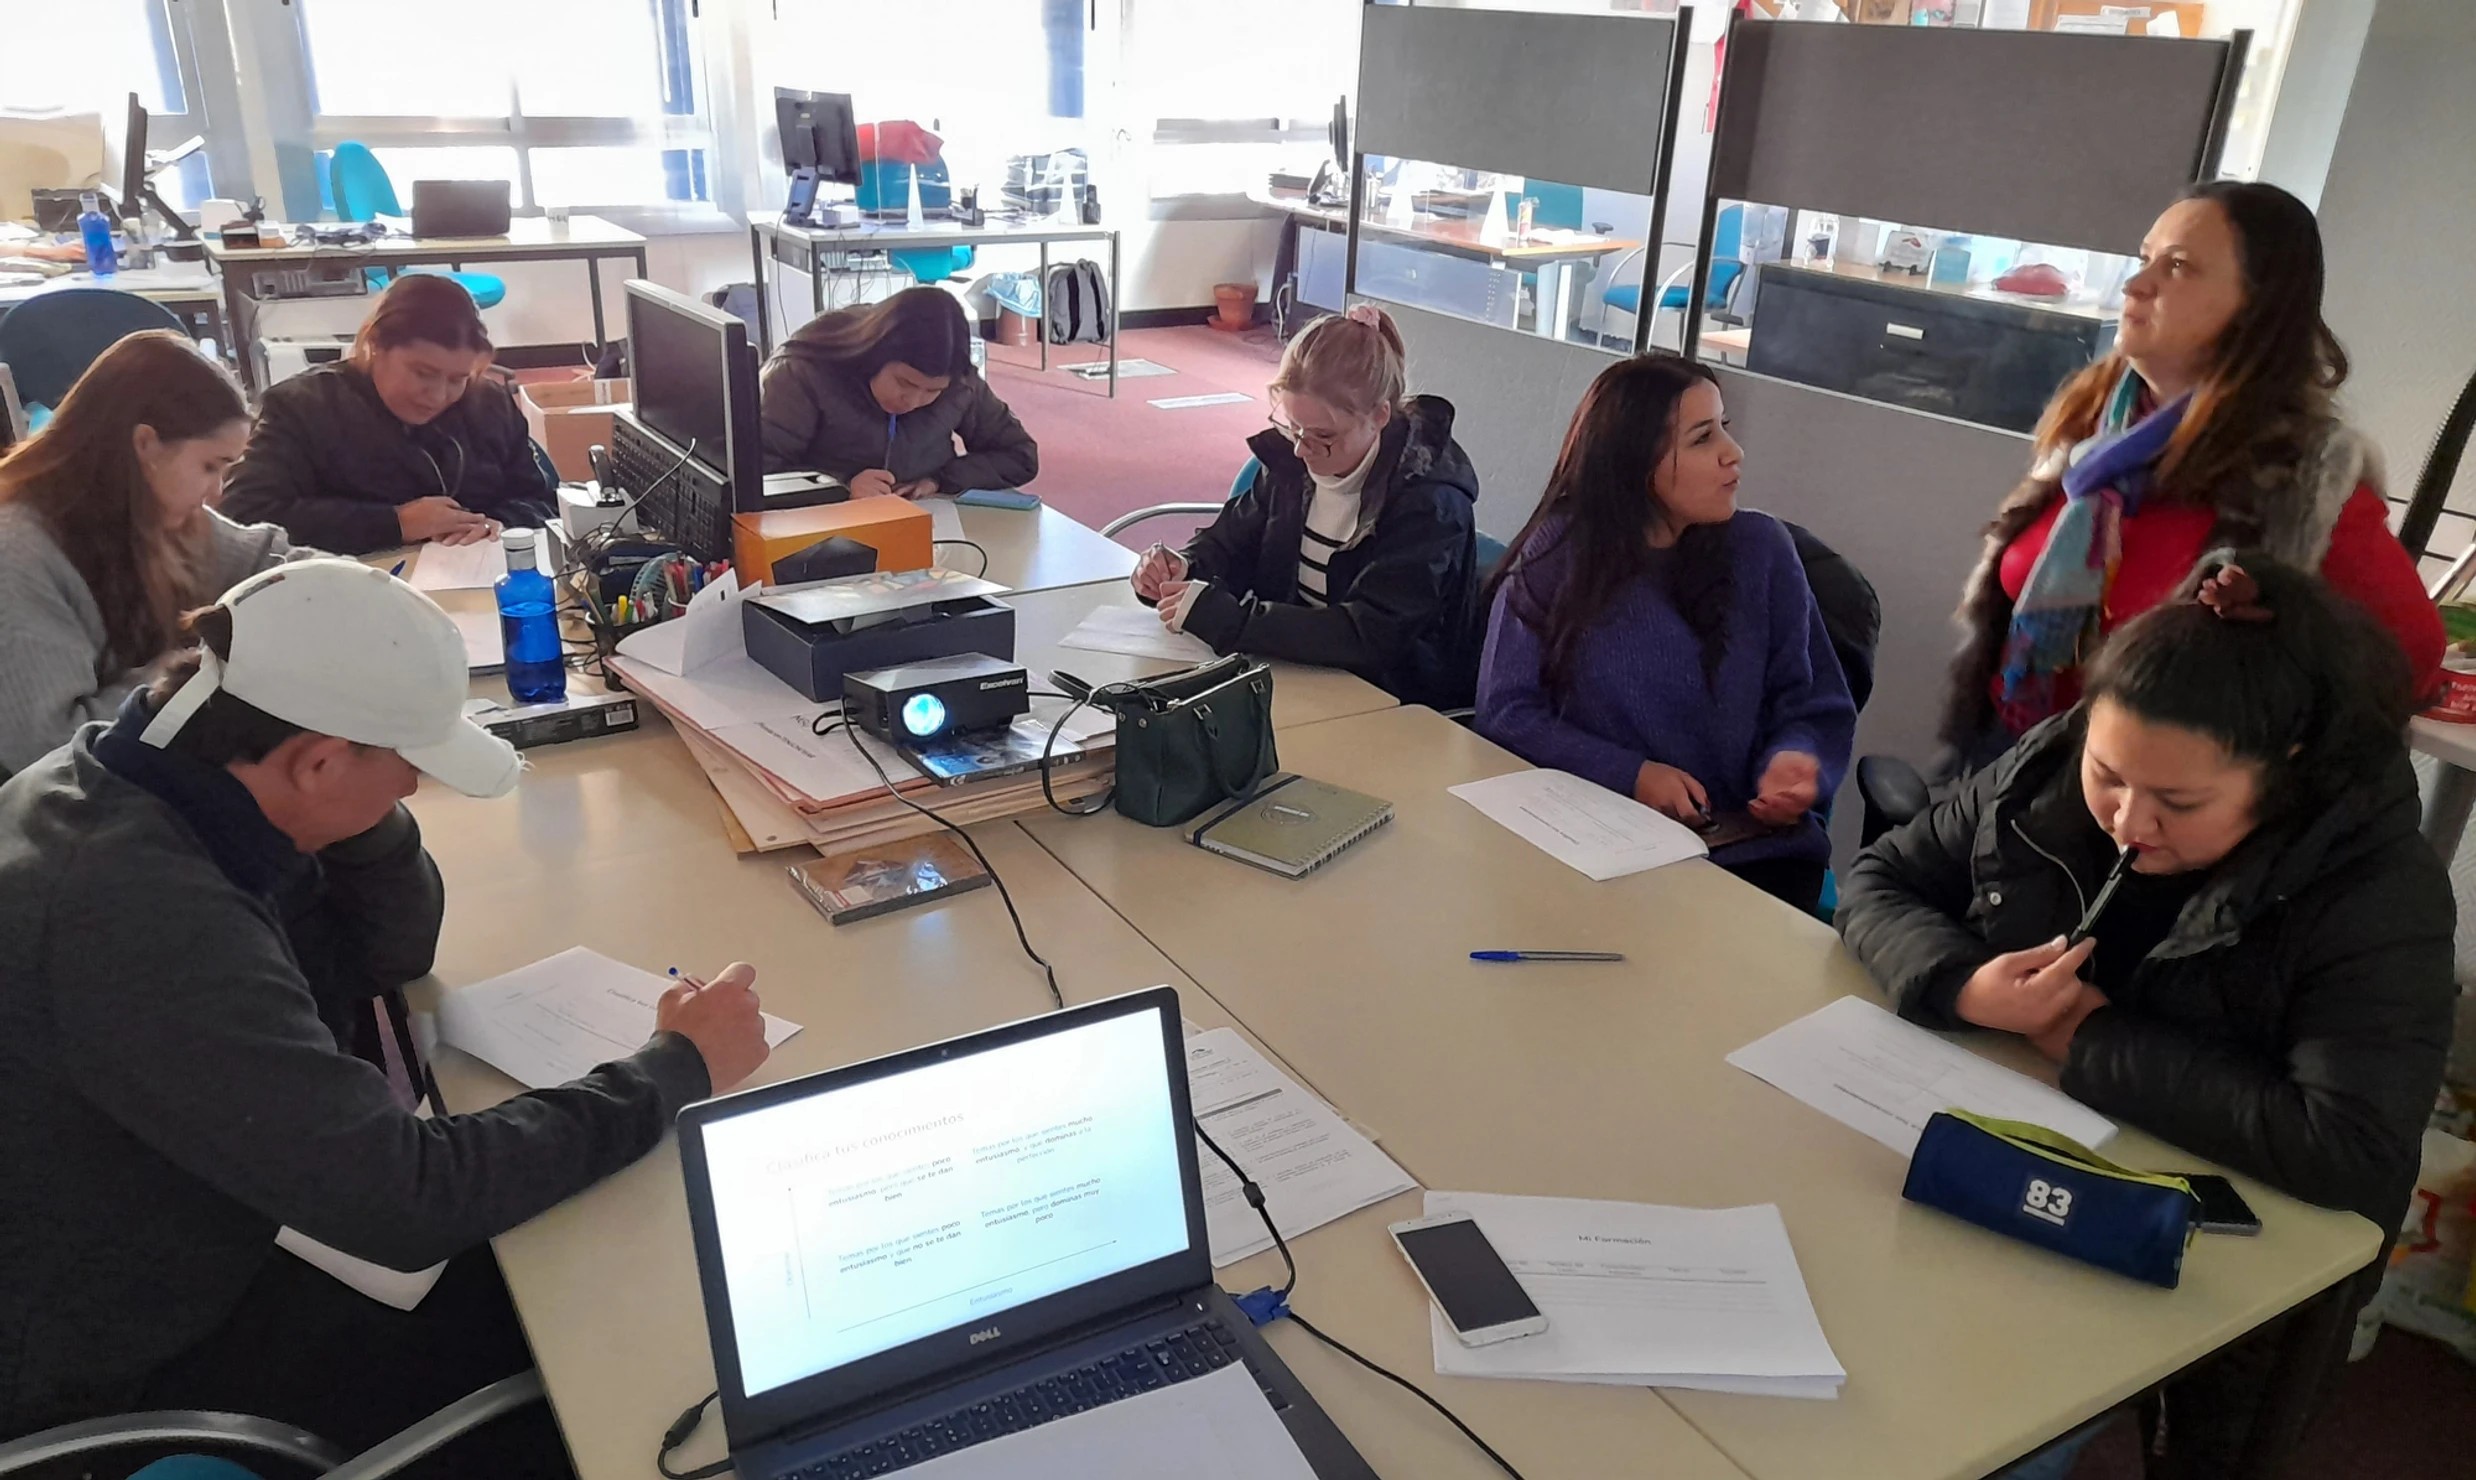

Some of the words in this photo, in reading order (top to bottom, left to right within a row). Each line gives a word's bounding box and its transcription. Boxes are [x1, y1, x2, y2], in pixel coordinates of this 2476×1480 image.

[1067, 1115, 1093, 1127] mucho
[862, 1111, 965, 1149] conocimientos
[932, 1156, 951, 1168] poco
[938, 1165, 953, 1176] dan
[981, 1206, 1005, 1219] Temas
[1006, 1202, 1019, 1213] por
[1076, 1177, 1101, 1190] mucho
[1050, 1193, 1082, 1208] dominas
[1083, 1188, 1101, 1199] muy
[2026, 1178, 2073, 1218] 83
[1035, 1211, 1054, 1224] poco
[940, 1220, 961, 1232] poco
[1594, 1234, 1652, 1246] Formación
[839, 1253, 888, 1274] entusiasmo
[912, 1242, 924, 1251] no
[946, 1230, 962, 1241] dan
[969, 1326, 1002, 1346] DELL
